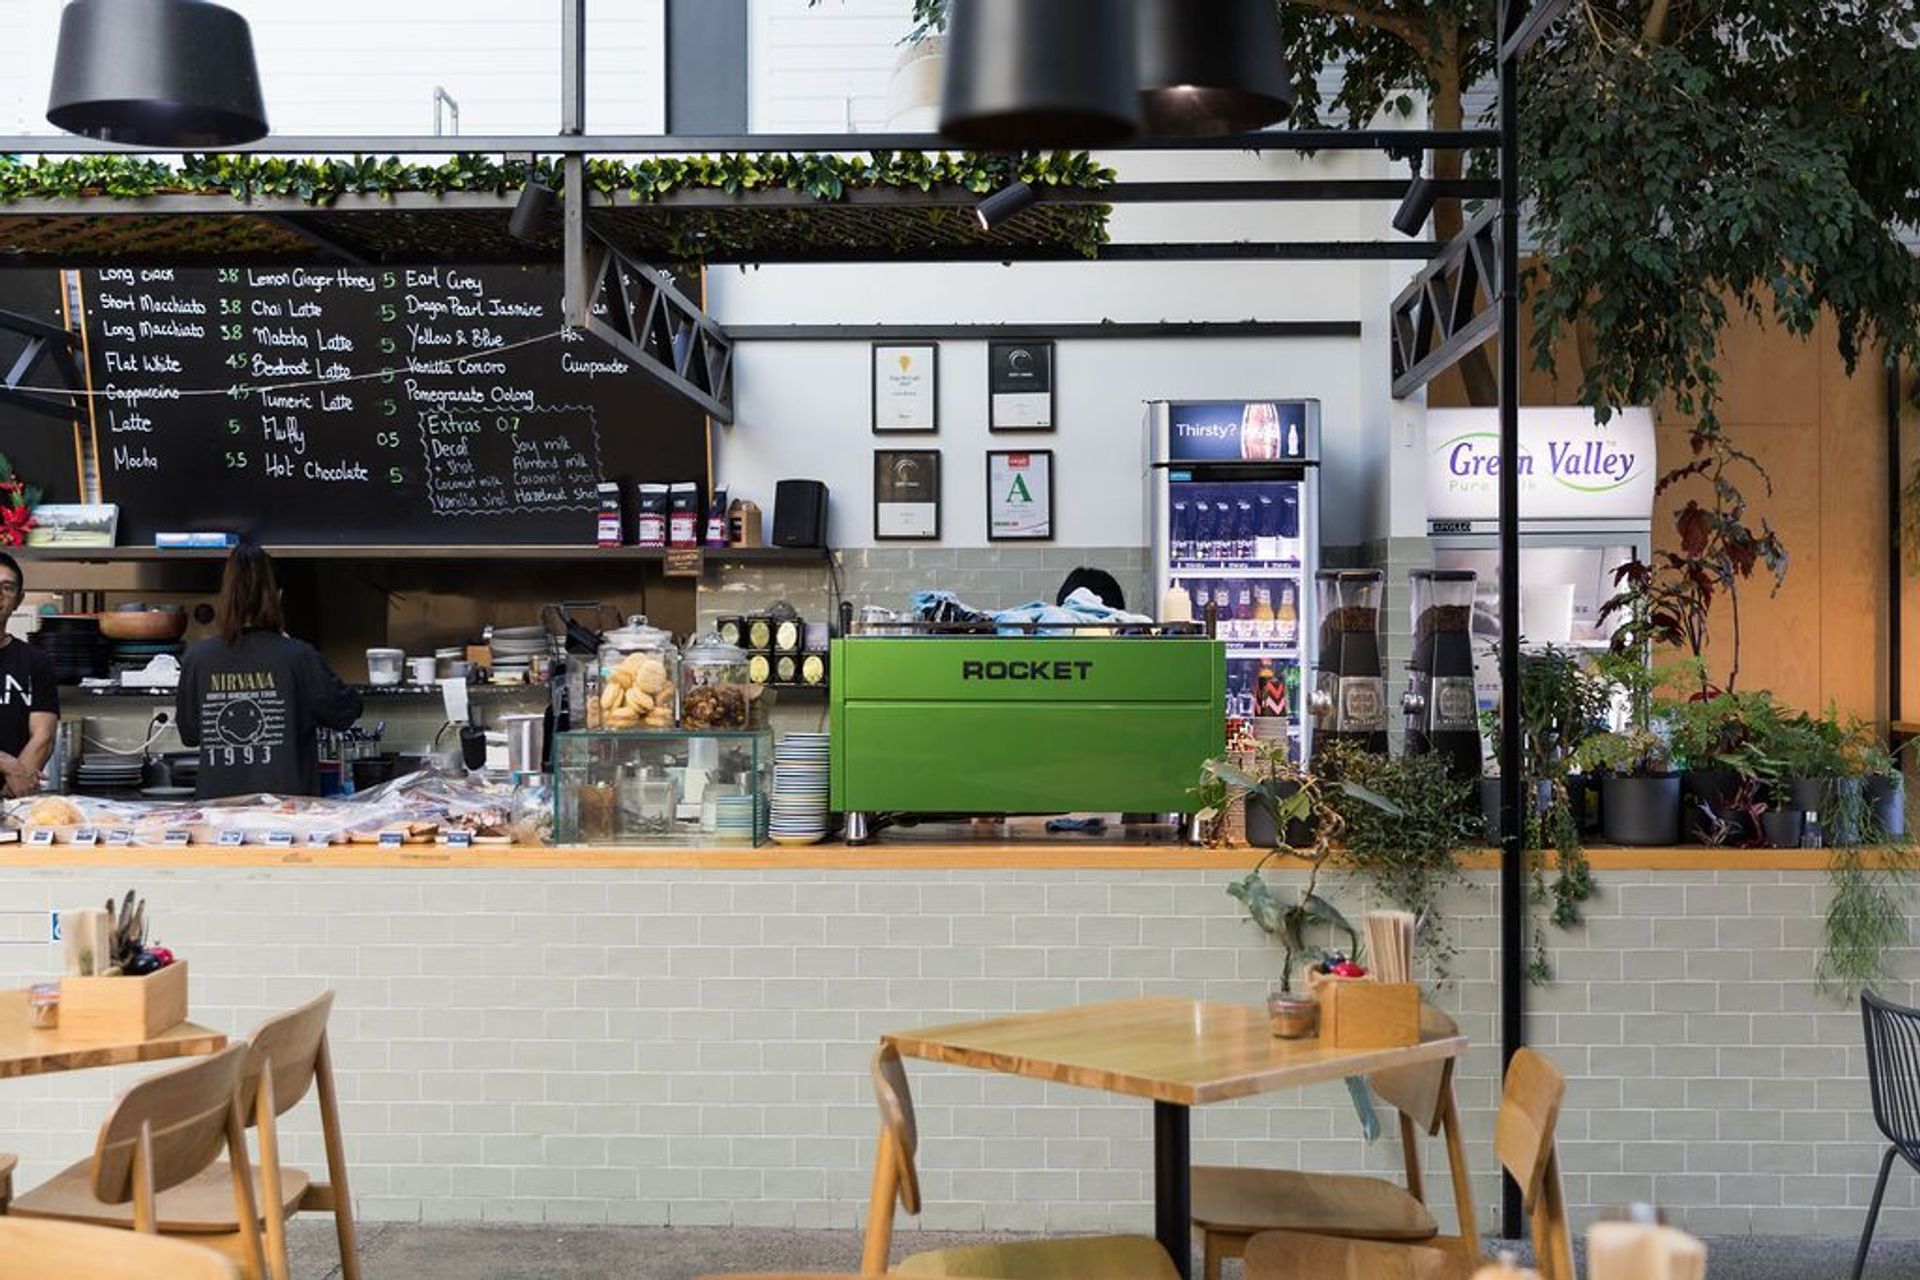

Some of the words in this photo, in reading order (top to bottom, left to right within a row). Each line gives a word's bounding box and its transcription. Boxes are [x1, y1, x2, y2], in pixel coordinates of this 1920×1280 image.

[247, 268, 290, 287] Lemon
[292, 268, 334, 293] Ginger
[336, 267, 376, 292] Honey
[383, 272, 396, 289] 5
[405, 267, 441, 288] Earl
[446, 270, 483, 297] Grey
[99, 292, 136, 311] Short
[139, 294, 206, 315] Macchiato
[220, 298, 241, 314] 3.8
[251, 300, 282, 316] Chai
[288, 299, 322, 317] Latte
[381, 304, 397, 322] 5
[405, 294, 449, 321] Dragon
[447, 296, 485, 316] Pearl
[488, 299, 544, 317] Jasmine
[103, 320, 136, 342] Long
[139, 320, 205, 338] Macchiato
[252, 326, 309, 349] Matcha
[316, 328, 354, 352] Latte
[381, 338, 396, 354] 5
[406, 323, 452, 352] Yellow
[456, 329, 468, 346] &
[471, 328, 505, 348] Blue
[105, 351, 138, 373] Flat
[143, 354, 183, 373] White
[251, 353, 312, 376] Beetroot
[315, 358, 352, 380] Latte
[380, 367, 395, 384] 5
[106, 383, 180, 408] Cappuccino
[257, 386, 313, 409] Tumeric
[320, 390, 355, 412] Latte
[384, 400, 397, 416] 5
[404, 379, 485, 411] Pomegranate
[491, 386, 534, 411] Oolong
[109, 409, 153, 433] Latte
[228, 420, 240, 435] 5
[261, 415, 305, 455] Fluffy
[428, 415, 482, 434] Extras
[1176, 423, 1238, 439] Thirsty?
[113, 445, 159, 470] Mocha
[431, 436, 469, 459] Decaf
[265, 453, 295, 478] Hot
[304, 460, 369, 482] Chocolate
[390, 467, 403, 483] 5
[1449, 442, 1534, 476] Gren
[1548, 441, 1635, 481] Valley
[1006, 472, 1032, 502] A
[211, 672, 275, 691] NIRVANA
[963, 660, 1094, 680] ROCKET
[209, 746, 271, 766] 1993
